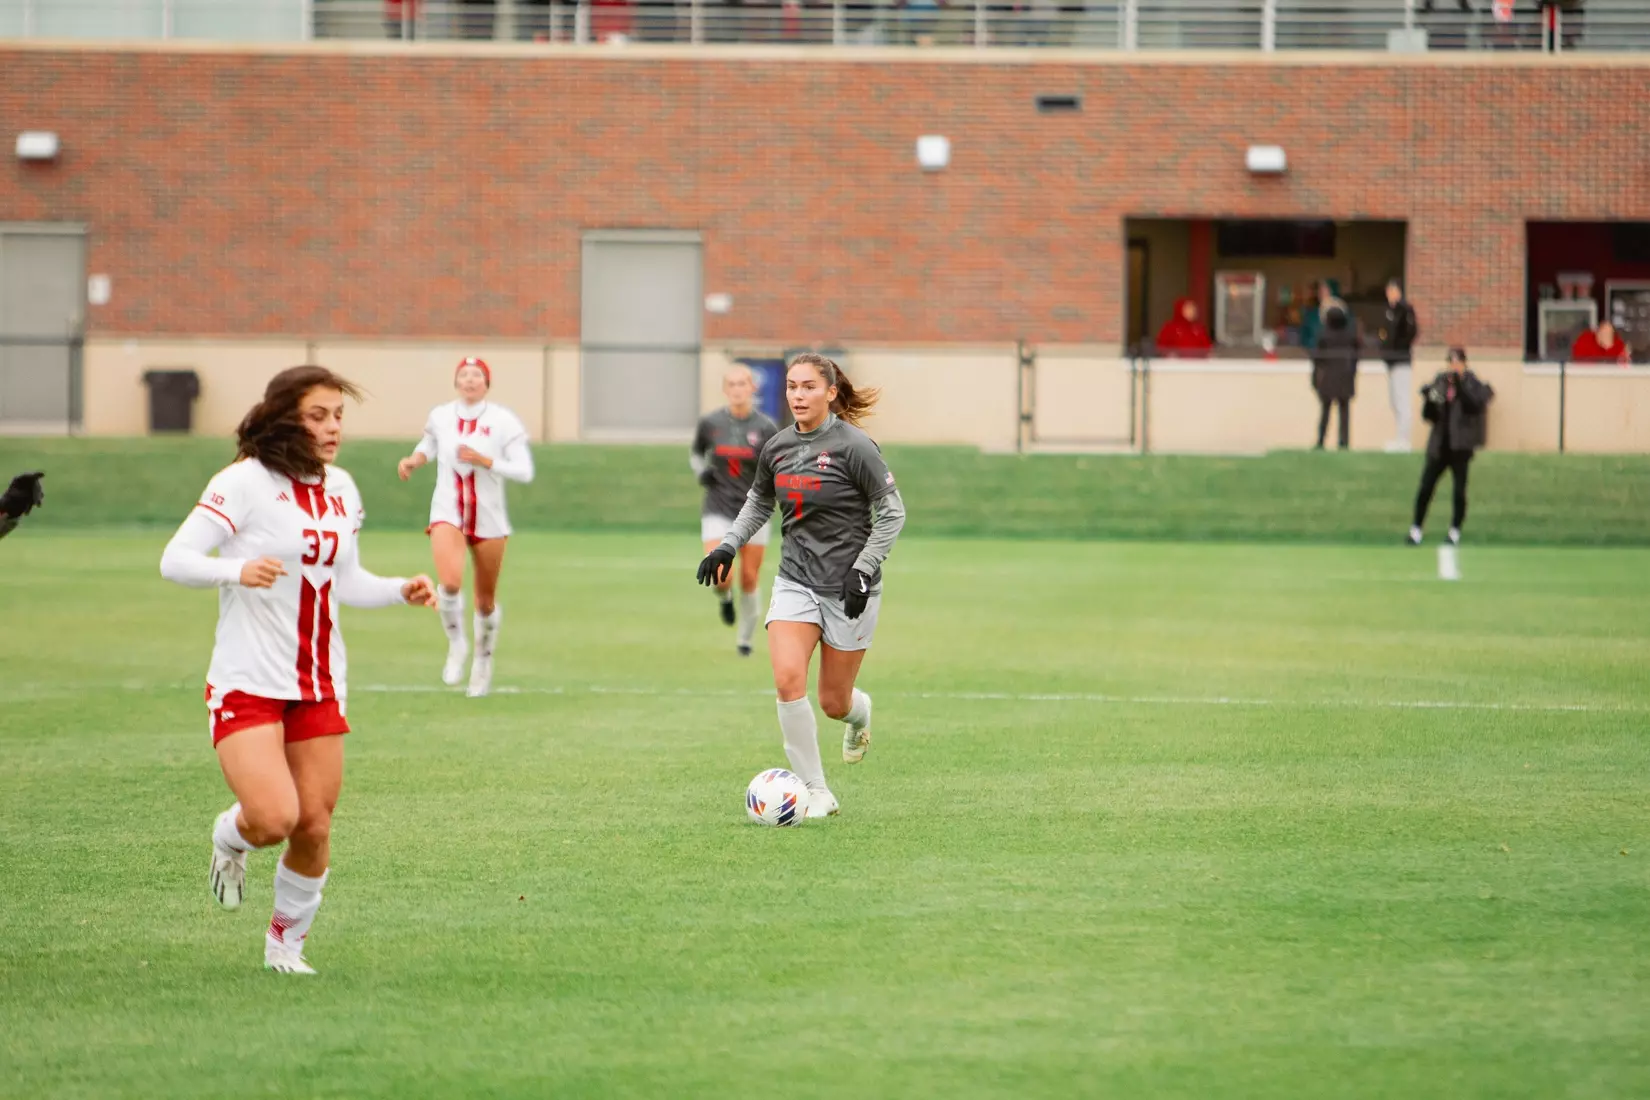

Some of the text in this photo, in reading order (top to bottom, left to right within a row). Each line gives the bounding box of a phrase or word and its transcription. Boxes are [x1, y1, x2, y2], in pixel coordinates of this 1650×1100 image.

[328, 495, 347, 518] N
[787, 491, 803, 520] 7
[301, 528, 339, 567] 37
